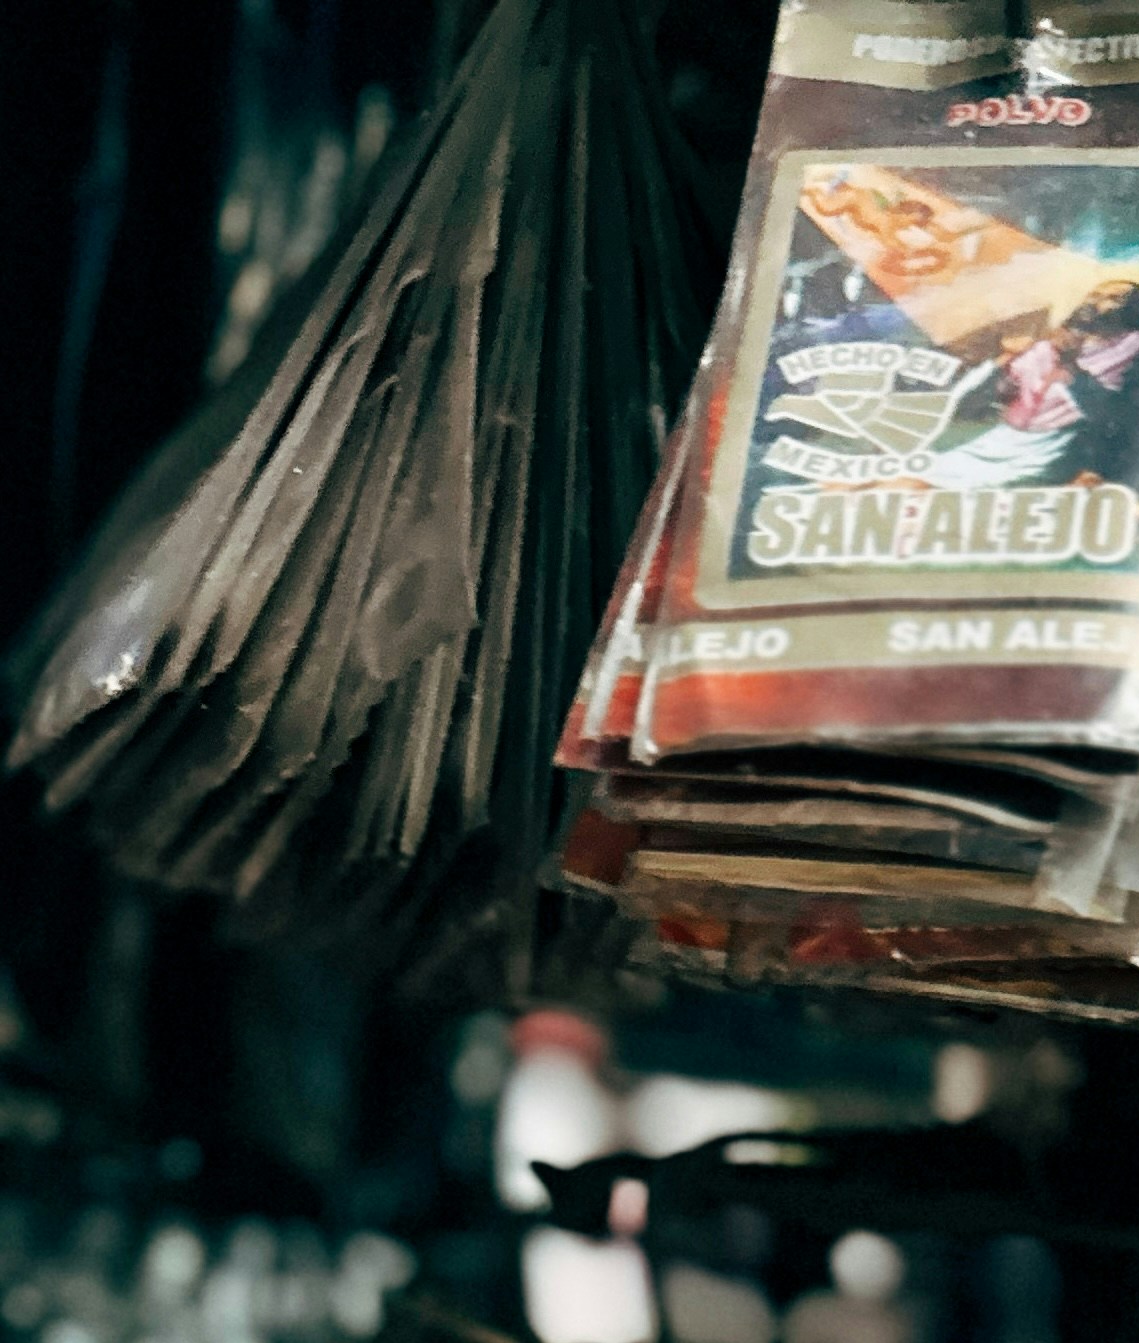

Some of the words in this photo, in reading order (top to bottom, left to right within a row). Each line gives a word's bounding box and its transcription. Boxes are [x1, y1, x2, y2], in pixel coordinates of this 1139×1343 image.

[946, 96, 1093, 127] POLVO
[783, 345, 902, 379] HECHO
[903, 349, 945, 379] EN
[774, 442, 934, 477] MEXICO
[747, 486, 901, 568] SAN
[913, 483, 1138, 564] ALEJO
[887, 621, 992, 651] SAN
